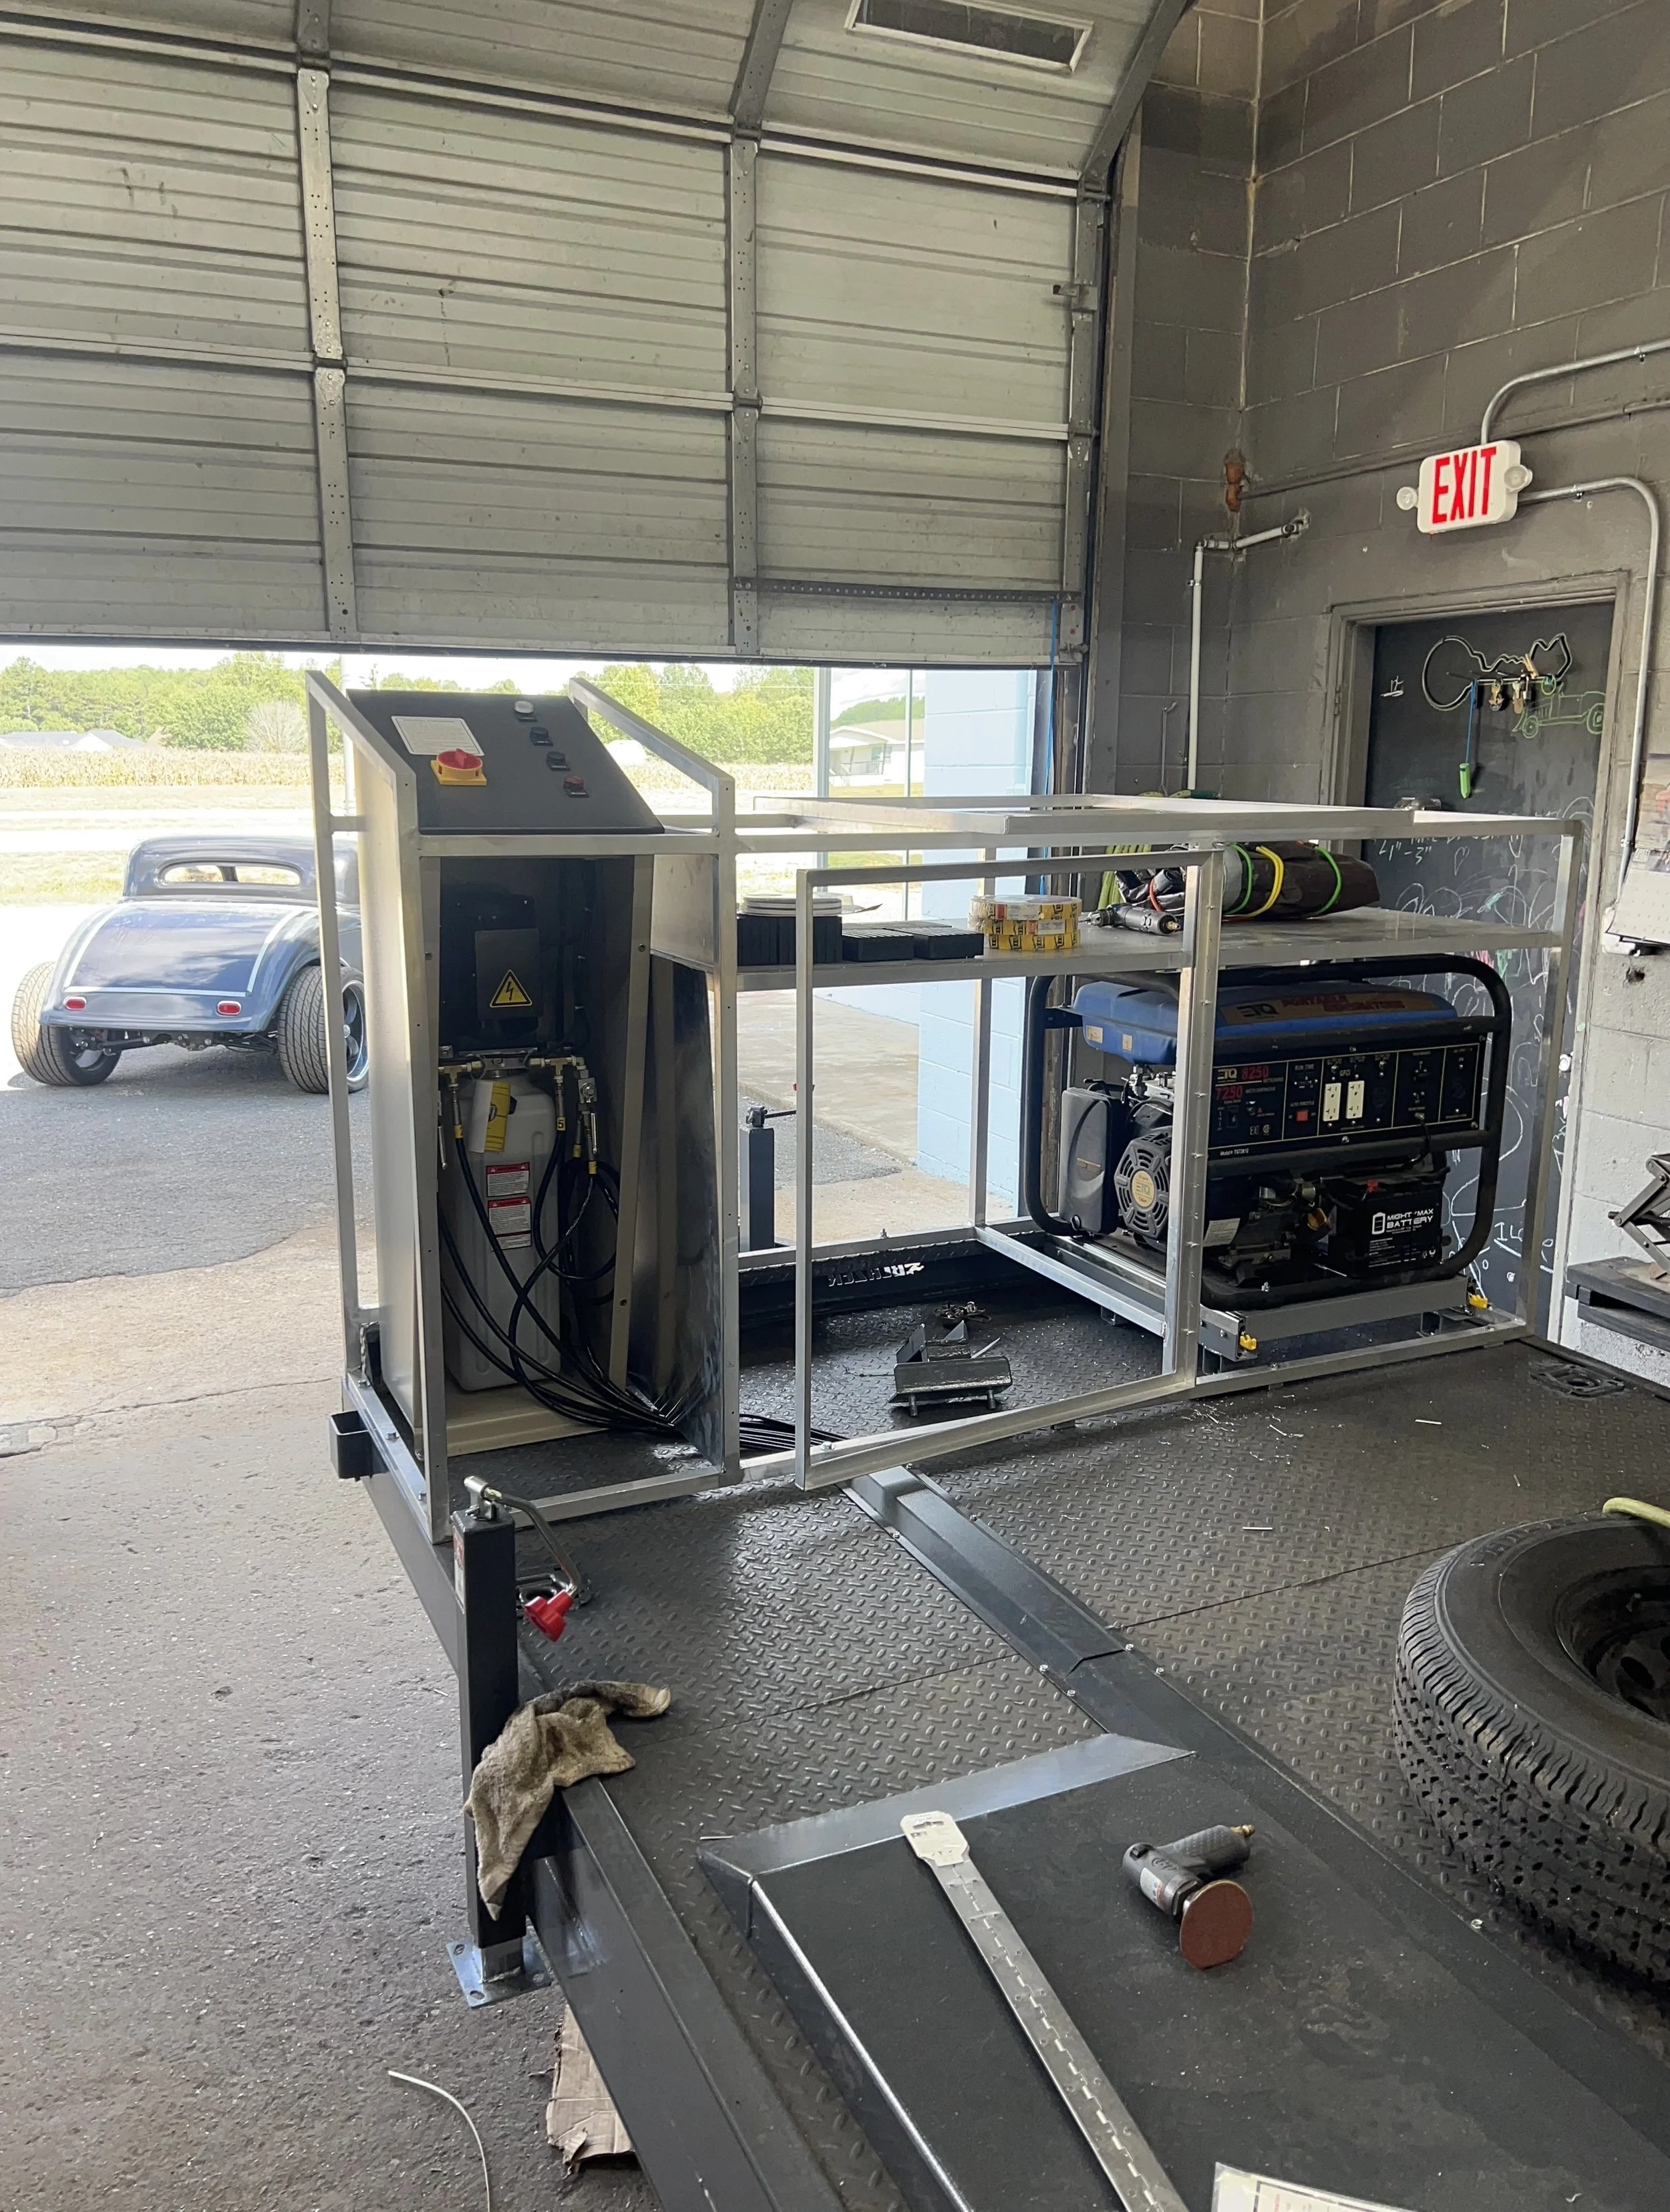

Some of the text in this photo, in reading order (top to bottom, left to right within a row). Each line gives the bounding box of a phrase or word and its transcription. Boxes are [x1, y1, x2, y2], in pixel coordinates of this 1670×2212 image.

[1432, 446, 1497, 524] EXIT
[1241, 1066, 1269, 1080] 8250
[1339, 1069, 1351, 1077] GFCI
[1215, 1085, 1243, 1101] 7250
[558, 1120, 564, 1129] 5
[1386, 1215, 1434, 1229] BATTERY
